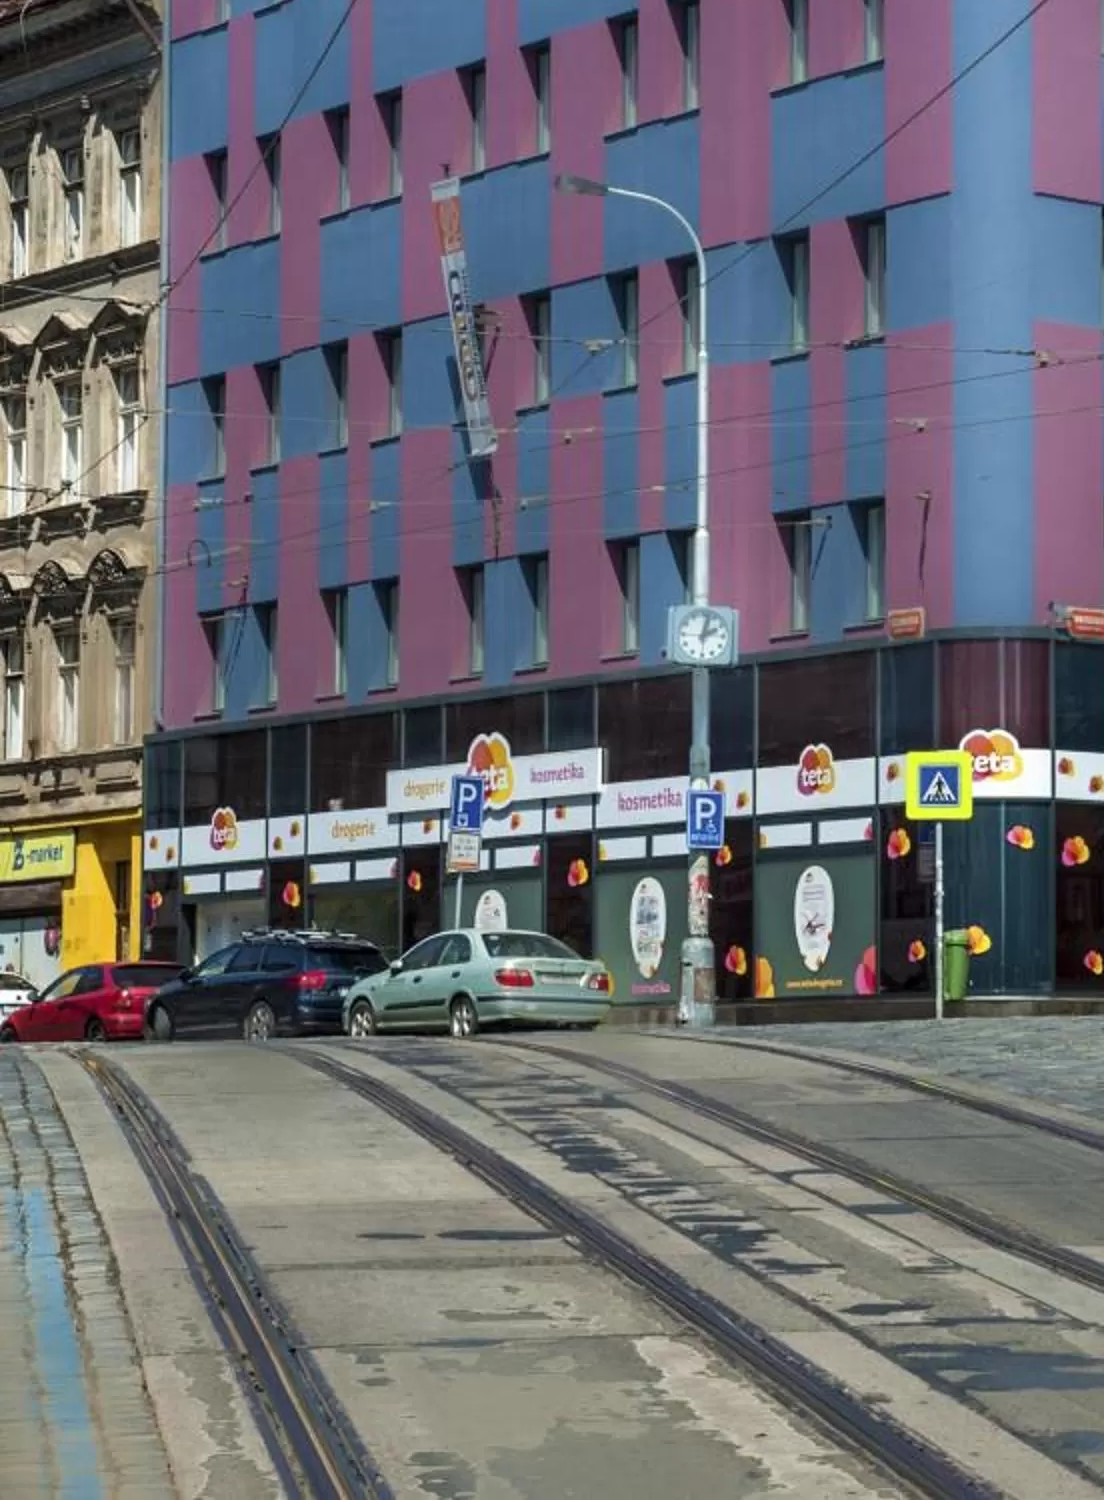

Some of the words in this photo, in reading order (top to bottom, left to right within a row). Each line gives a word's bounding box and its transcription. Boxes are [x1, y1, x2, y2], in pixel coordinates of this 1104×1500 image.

[971, 751, 1014, 773] eta
[404, 778, 446, 800] drogerie
[530, 762, 584, 783] kosmetika
[801, 765, 832, 786] teta
[459, 783, 477, 813] P
[617, 788, 682, 812] kosmetika
[695, 797, 717, 830] P
[331, 818, 375, 841] drogerie
